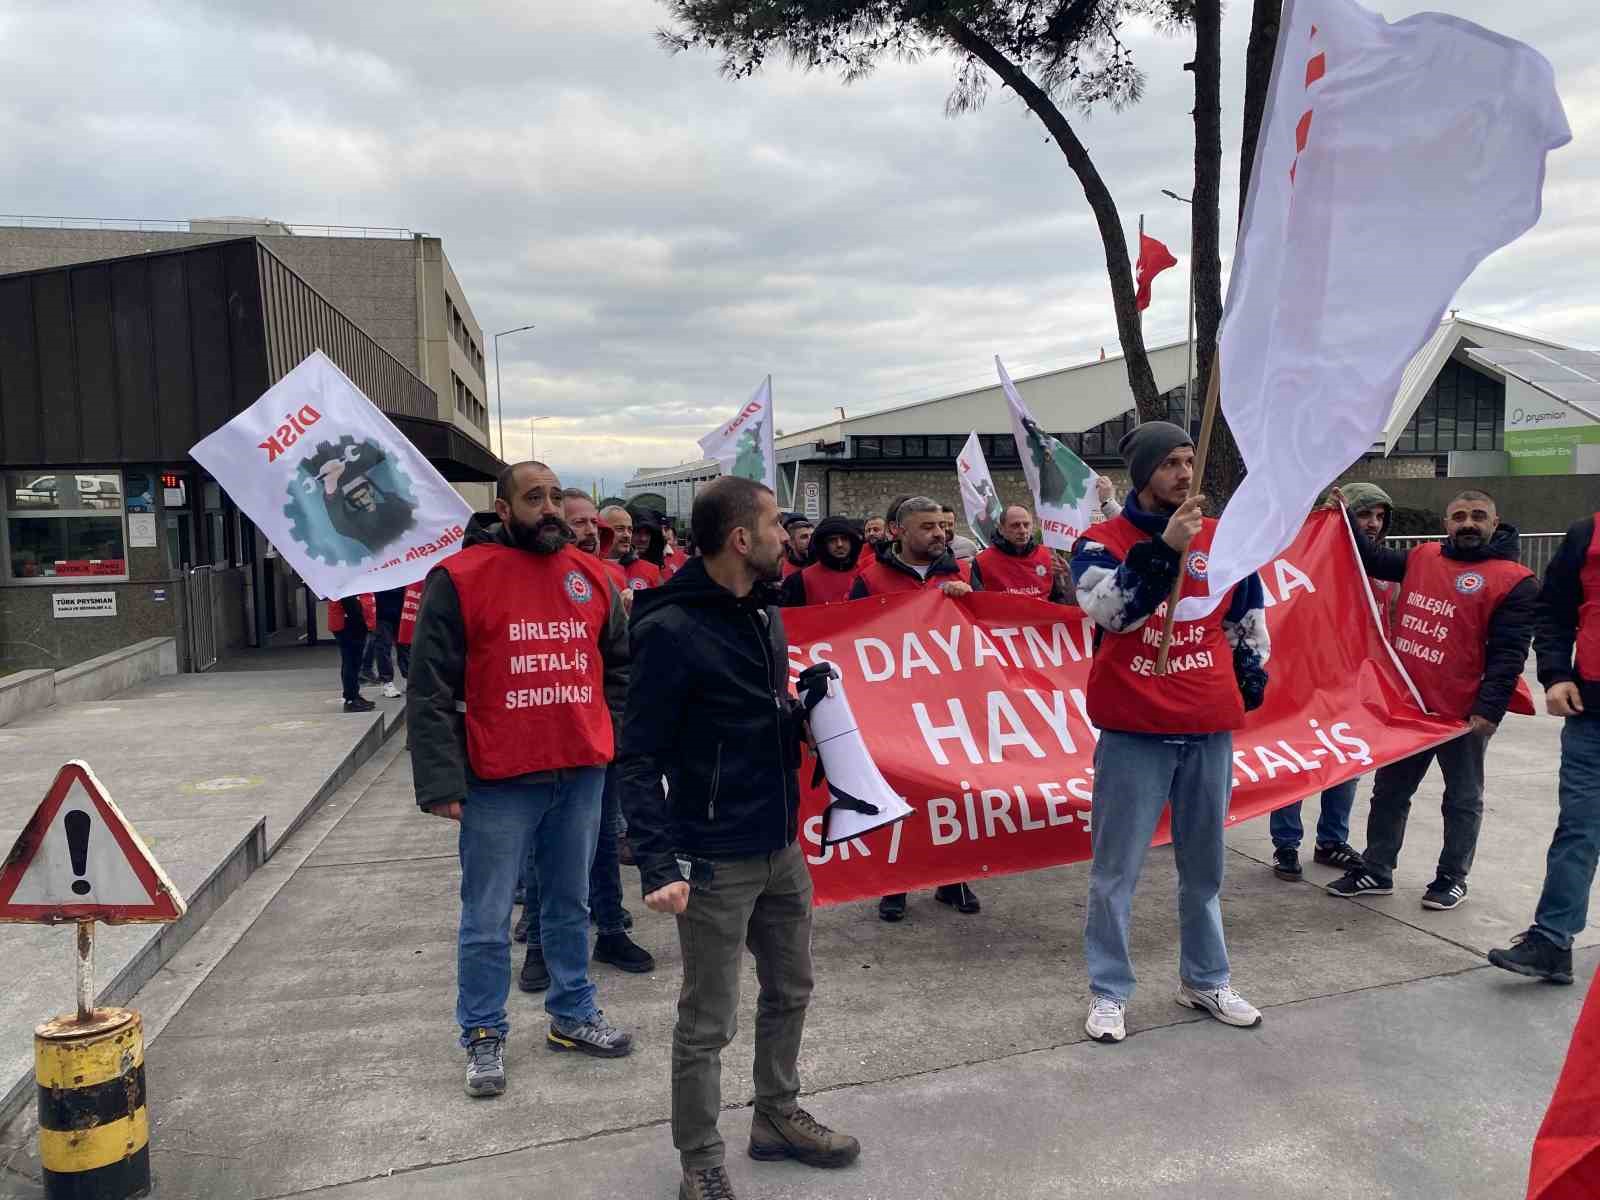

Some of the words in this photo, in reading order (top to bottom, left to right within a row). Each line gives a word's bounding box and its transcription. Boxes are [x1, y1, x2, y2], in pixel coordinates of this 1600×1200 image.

[508, 617, 588, 644] BİRLEŞİK
[510, 648, 588, 675] METAL-İŞ
[505, 681, 592, 710] SENDİKASI
[927, 767, 1095, 847] BİRLEŞ
[1231, 718, 1374, 787] TAL-İŞ
